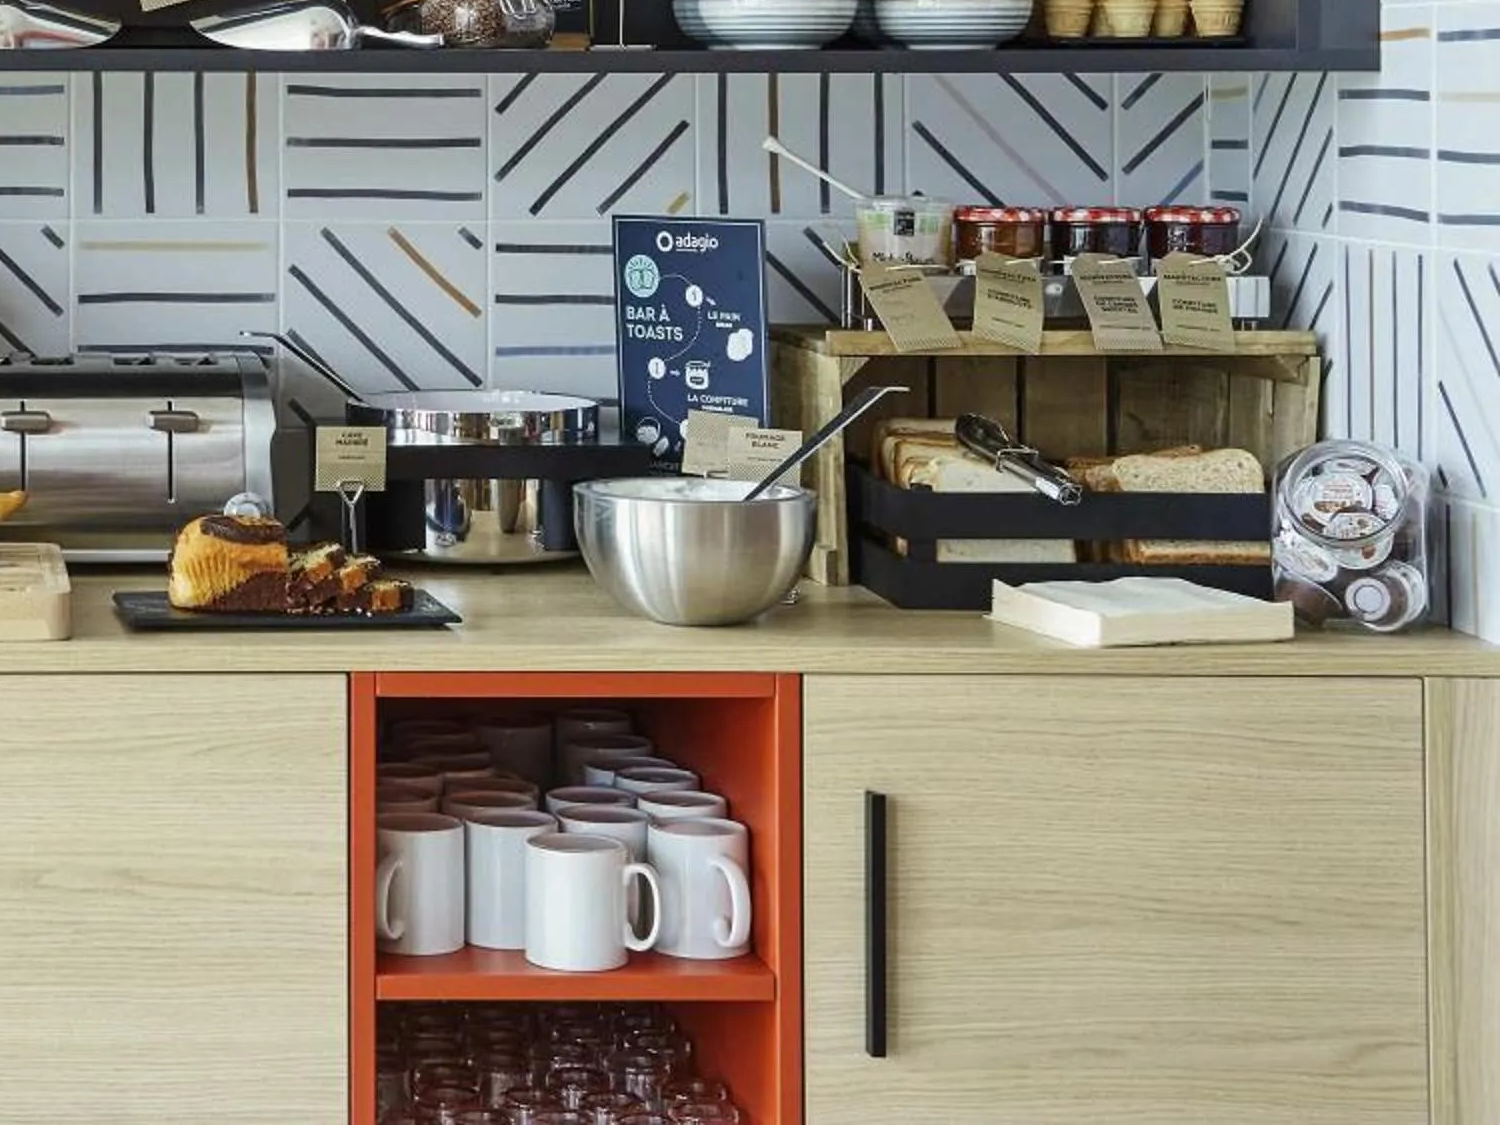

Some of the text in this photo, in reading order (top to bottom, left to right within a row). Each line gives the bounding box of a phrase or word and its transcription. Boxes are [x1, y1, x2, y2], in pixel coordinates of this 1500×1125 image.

[675, 231, 719, 252] adagio
[626, 305, 656, 321] BAR
[626, 323, 684, 341] TOASTS
